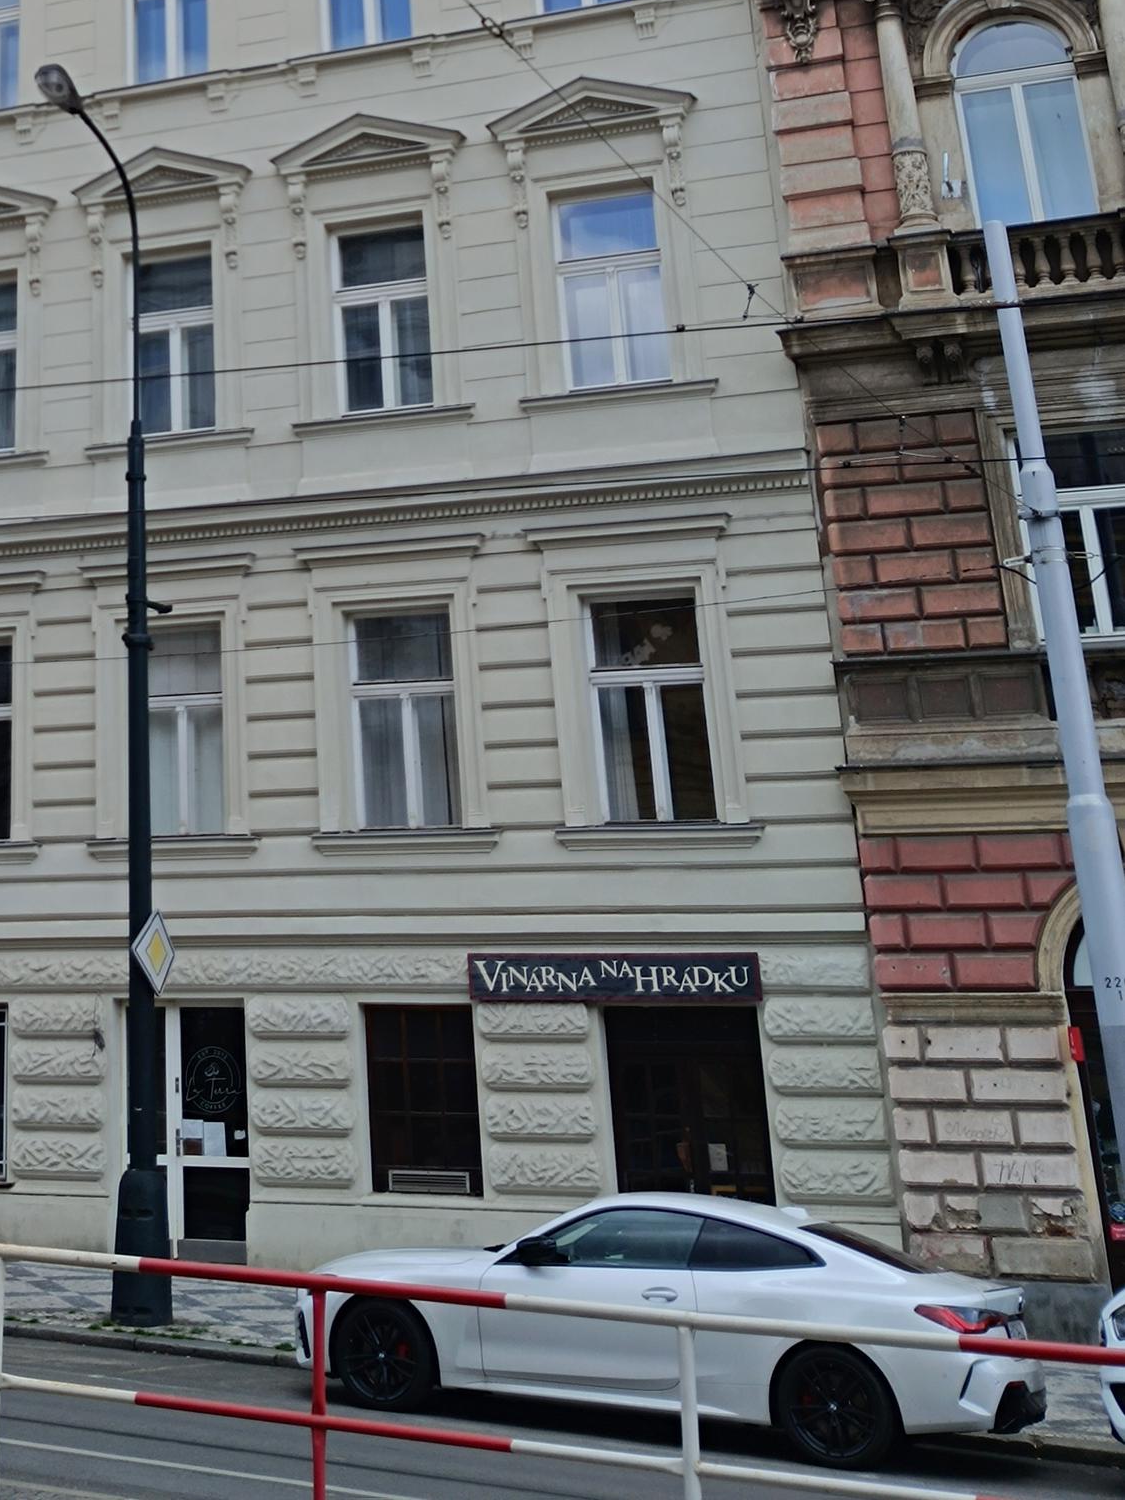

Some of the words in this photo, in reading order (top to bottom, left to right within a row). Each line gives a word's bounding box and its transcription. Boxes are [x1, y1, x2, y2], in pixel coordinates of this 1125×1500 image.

[475, 960, 597, 992] VINÁRNA
[599, 960, 635, 979] NA
[633, 964, 749, 993] HRÁDKU
[1105, 976, 1125, 988] 22
